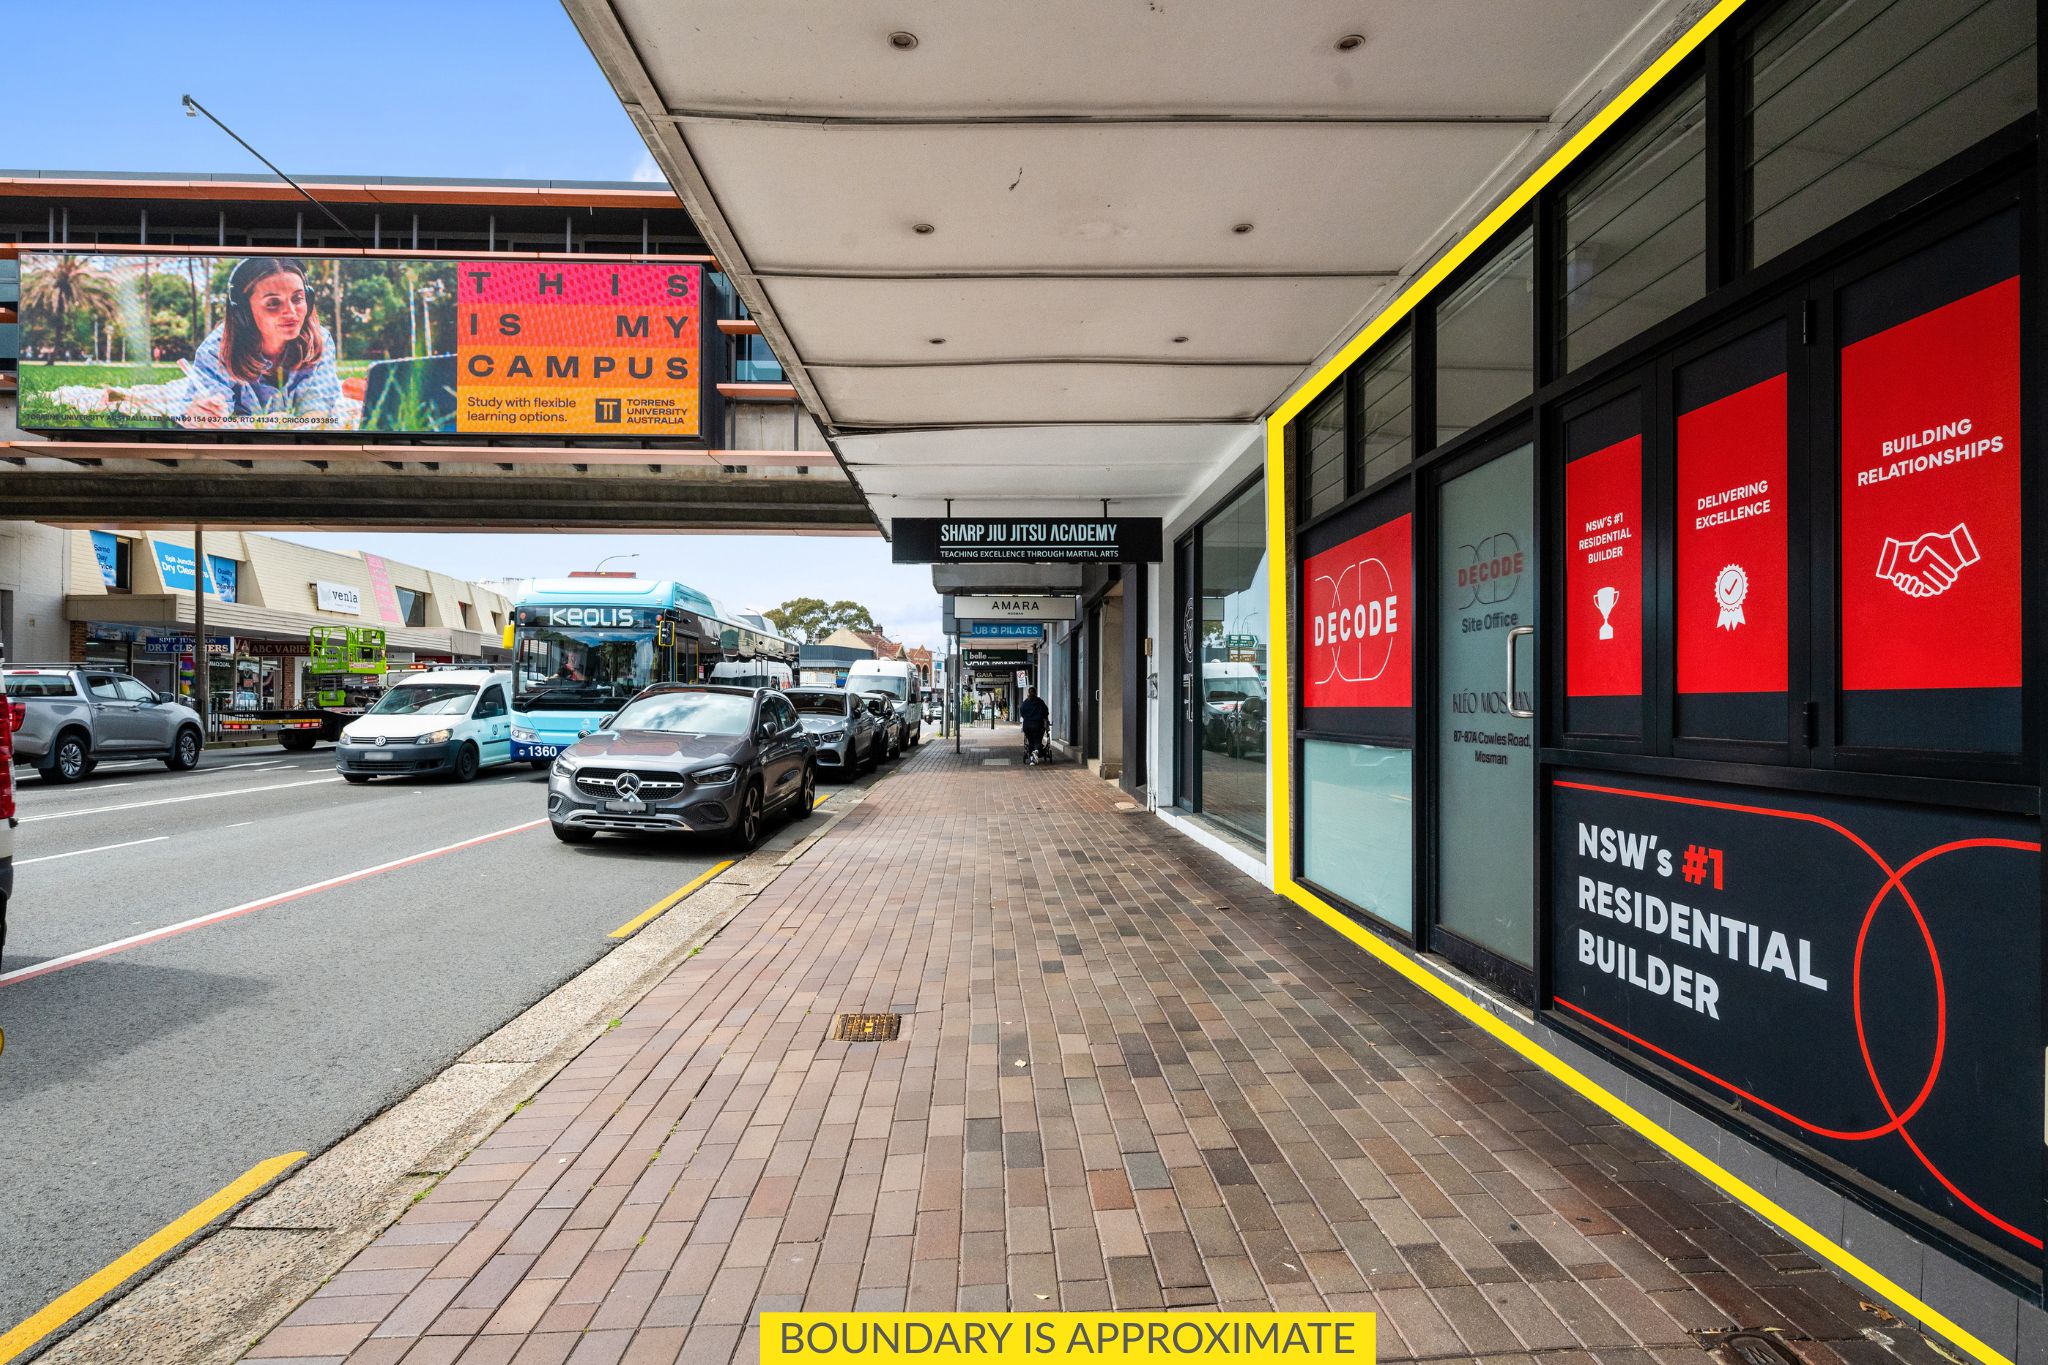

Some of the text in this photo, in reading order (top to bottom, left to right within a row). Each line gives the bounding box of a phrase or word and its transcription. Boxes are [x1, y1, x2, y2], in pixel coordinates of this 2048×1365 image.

[468, 271, 689, 297] THIS
[470, 313, 689, 338] IS MY
[467, 354, 689, 380] CAMPUS
[467, 397, 577, 409] Study with flexible
[627, 399, 675, 407] TORRENS
[467, 410, 568, 424] learning options.
[626, 408, 688, 416] UNIVERSITY
[626, 417, 685, 425] AUSTRALIA
[1882, 418, 1972, 457] BUILDING
[1857, 435, 2004, 487] RELATIONSHIPS
[1697, 480, 1768, 511] DELIVERING
[1613, 512, 1623, 525] #1
[1695, 499, 1771, 530] EXCELLENCE
[941, 524, 1117, 542] SHARP JIU JITSU ACADEMY
[1578, 527, 1632, 550] RESIDENTIAL
[980, 550, 1025, 558] EXCELLENCE
[1027, 550, 1064, 558] THROUGH
[1066, 550, 1098, 558] MARTIAL
[1100, 550, 1119, 558] ARTS
[1588, 546, 1623, 564] BUILDER
[161, 562, 176, 574] Dry
[1458, 552, 1524, 587] DECODE
[332, 590, 358, 603] venla
[992, 601, 1039, 610] AMARA
[1315, 595, 1397, 646] DECODE
[1461, 611, 1518, 634] Site Office
[1000, 626, 1038, 635] PILATES
[148, 644, 168, 652] DRY
[159, 637, 177, 645] SPIT
[252, 643, 273, 653] ABC
[1453, 730, 1477, 744] 87-87A
[1478, 731, 1507, 746] Cowles
[528, 746, 557, 757] 1360
[1475, 750, 1508, 766] Mosman
[1578, 822, 1724, 891] NSW's #1
[1578, 875, 1828, 991] RESIDENTIAL
[1578, 928, 1720, 1020] BUILDER
